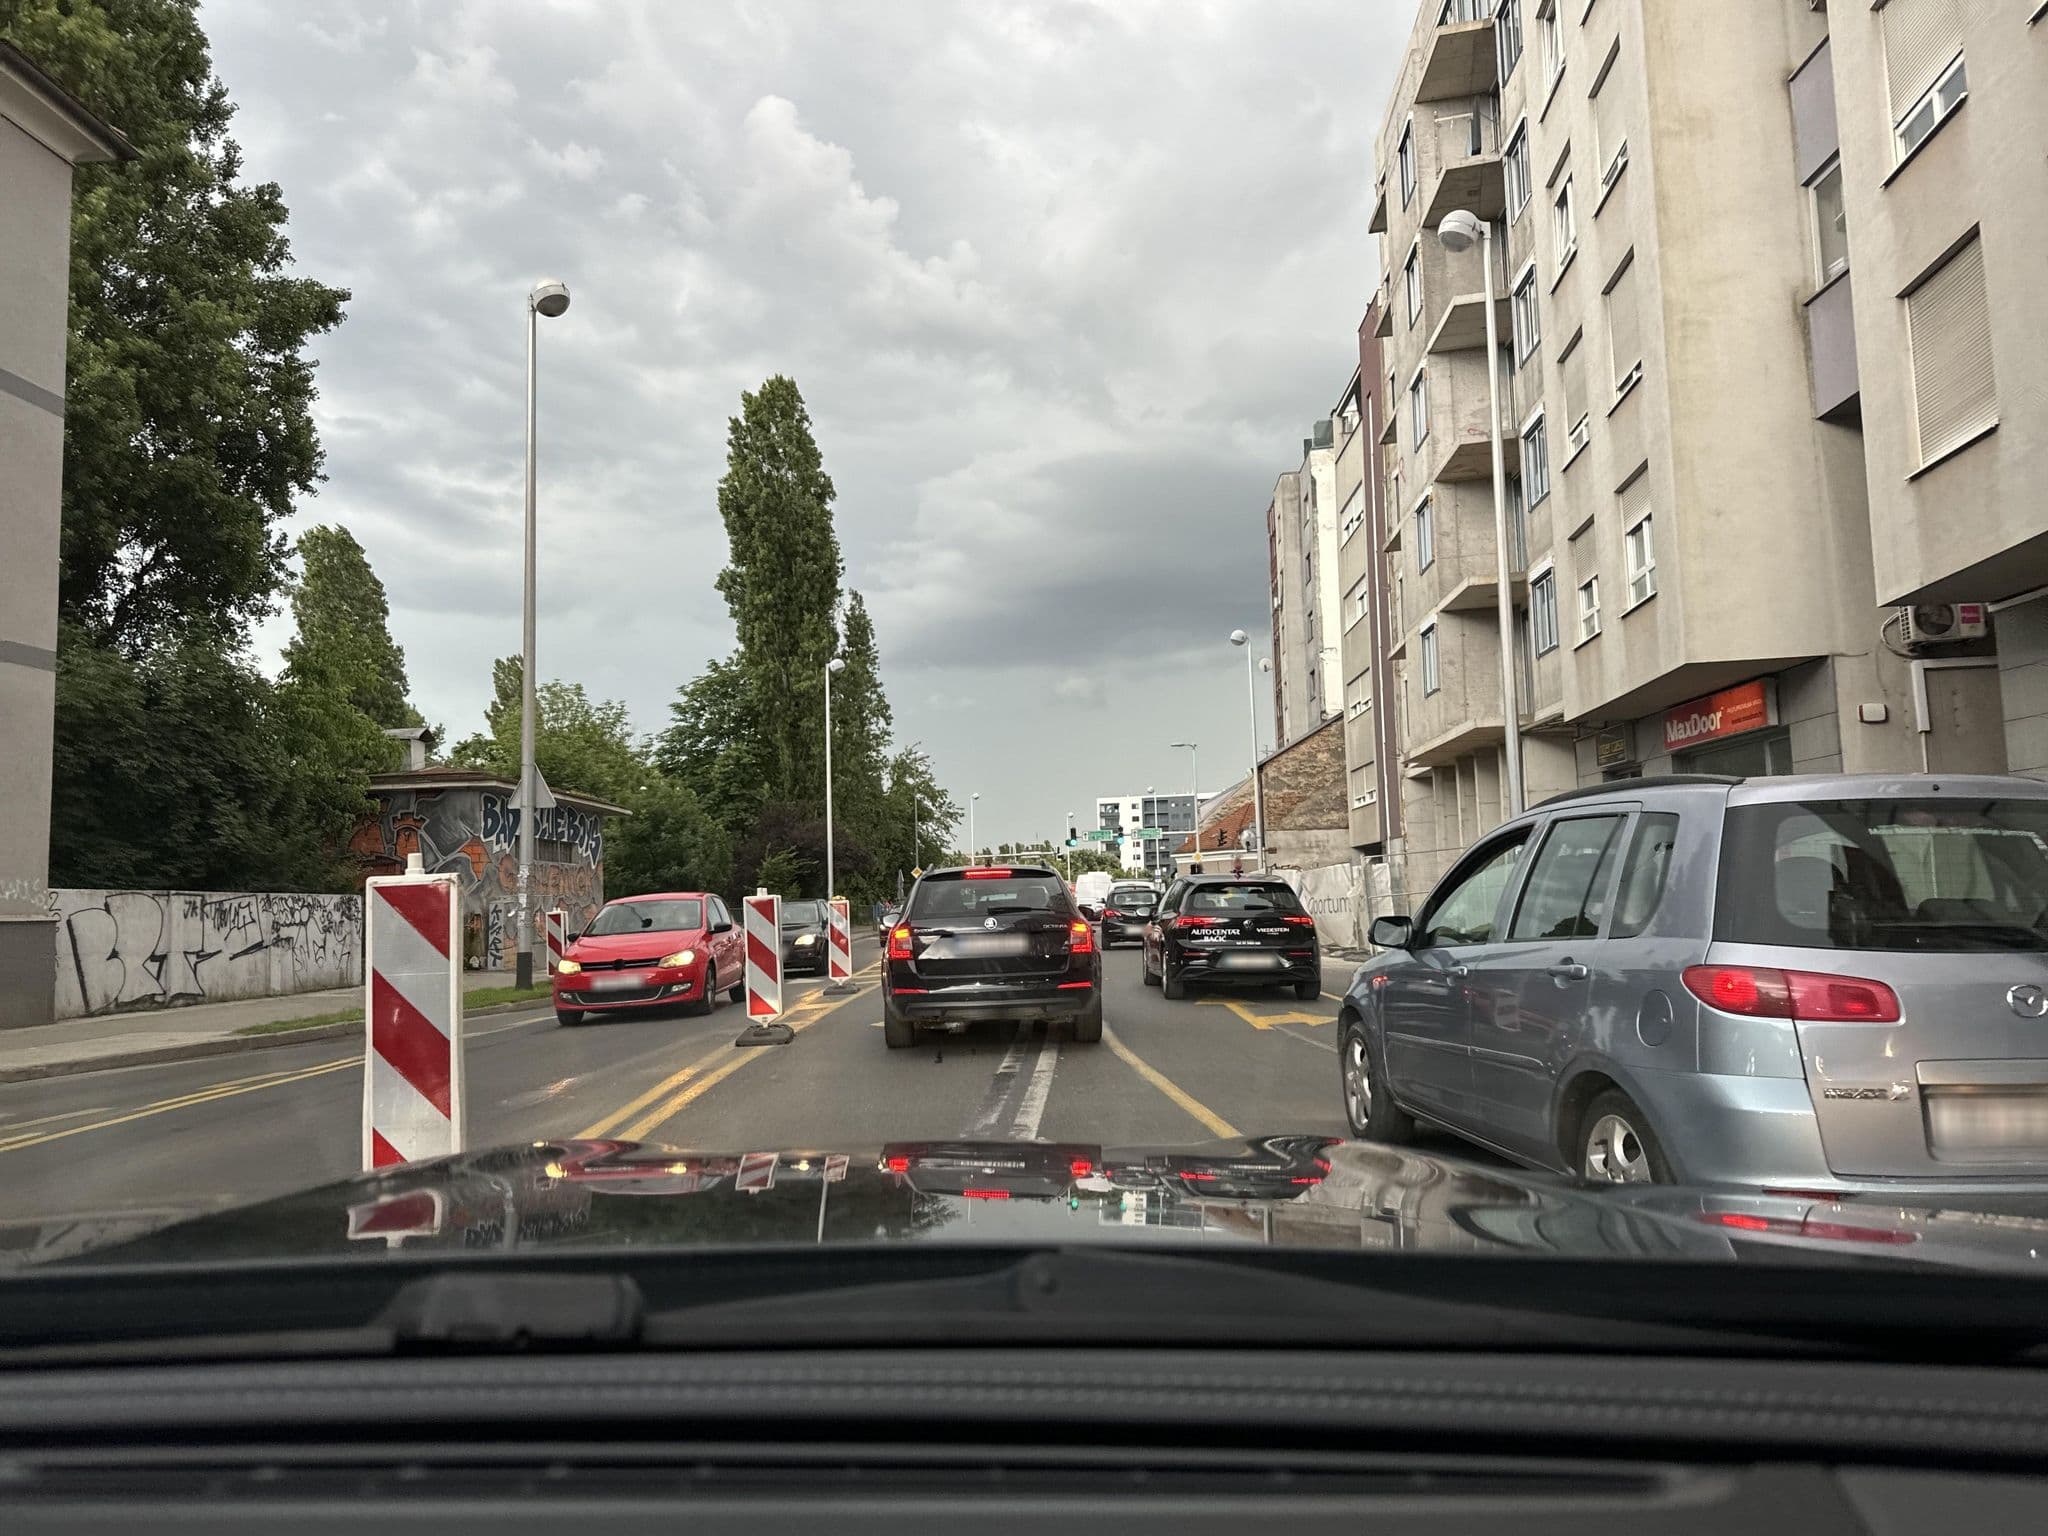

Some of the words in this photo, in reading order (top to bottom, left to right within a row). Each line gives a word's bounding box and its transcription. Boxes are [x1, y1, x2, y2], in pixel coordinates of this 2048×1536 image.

[1666, 711, 1722, 742] MaxDoor
[481, 793, 522, 854] BAD
[566, 806, 602, 869] BOYS
